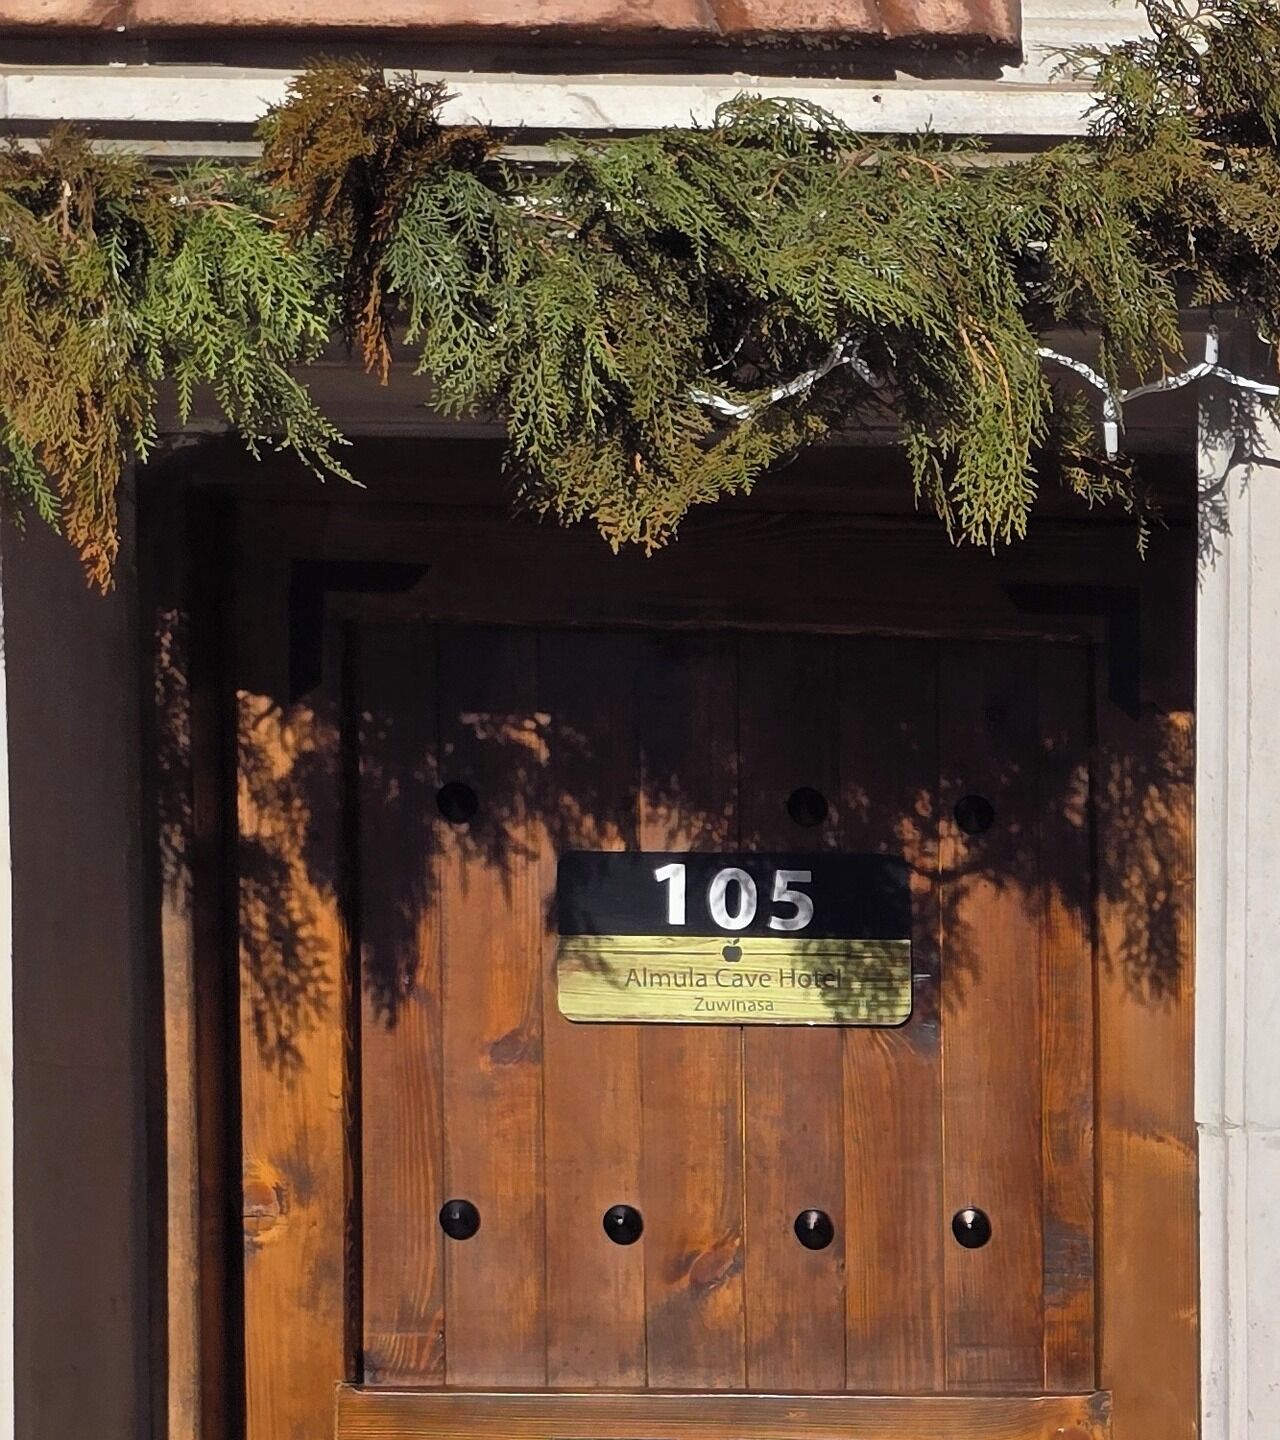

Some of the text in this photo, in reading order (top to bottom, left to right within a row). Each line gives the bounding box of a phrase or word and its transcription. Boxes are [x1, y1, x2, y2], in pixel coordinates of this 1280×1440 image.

[654, 863, 815, 931] 105
[624, 967, 843, 989] Almula Cave Hotel
[693, 997, 775, 1013] Zuwinasa
